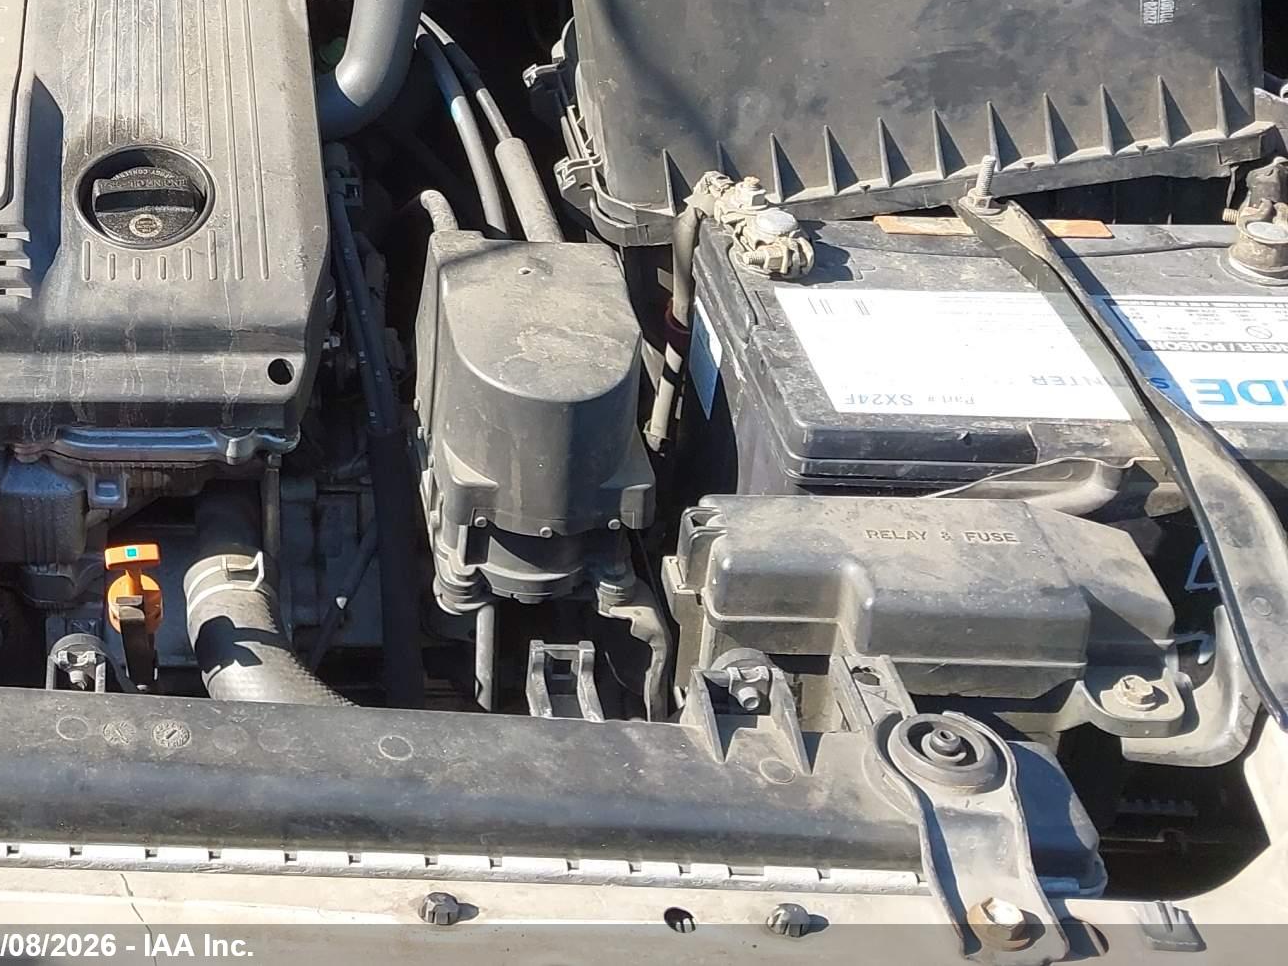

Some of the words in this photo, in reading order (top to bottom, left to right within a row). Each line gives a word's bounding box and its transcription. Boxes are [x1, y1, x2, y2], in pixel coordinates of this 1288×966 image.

[845, 392, 914, 406] SX24F
[865, 528, 927, 541] RELAY
[939, 530, 953, 541] &
[963, 530, 1018, 543] FUSE
